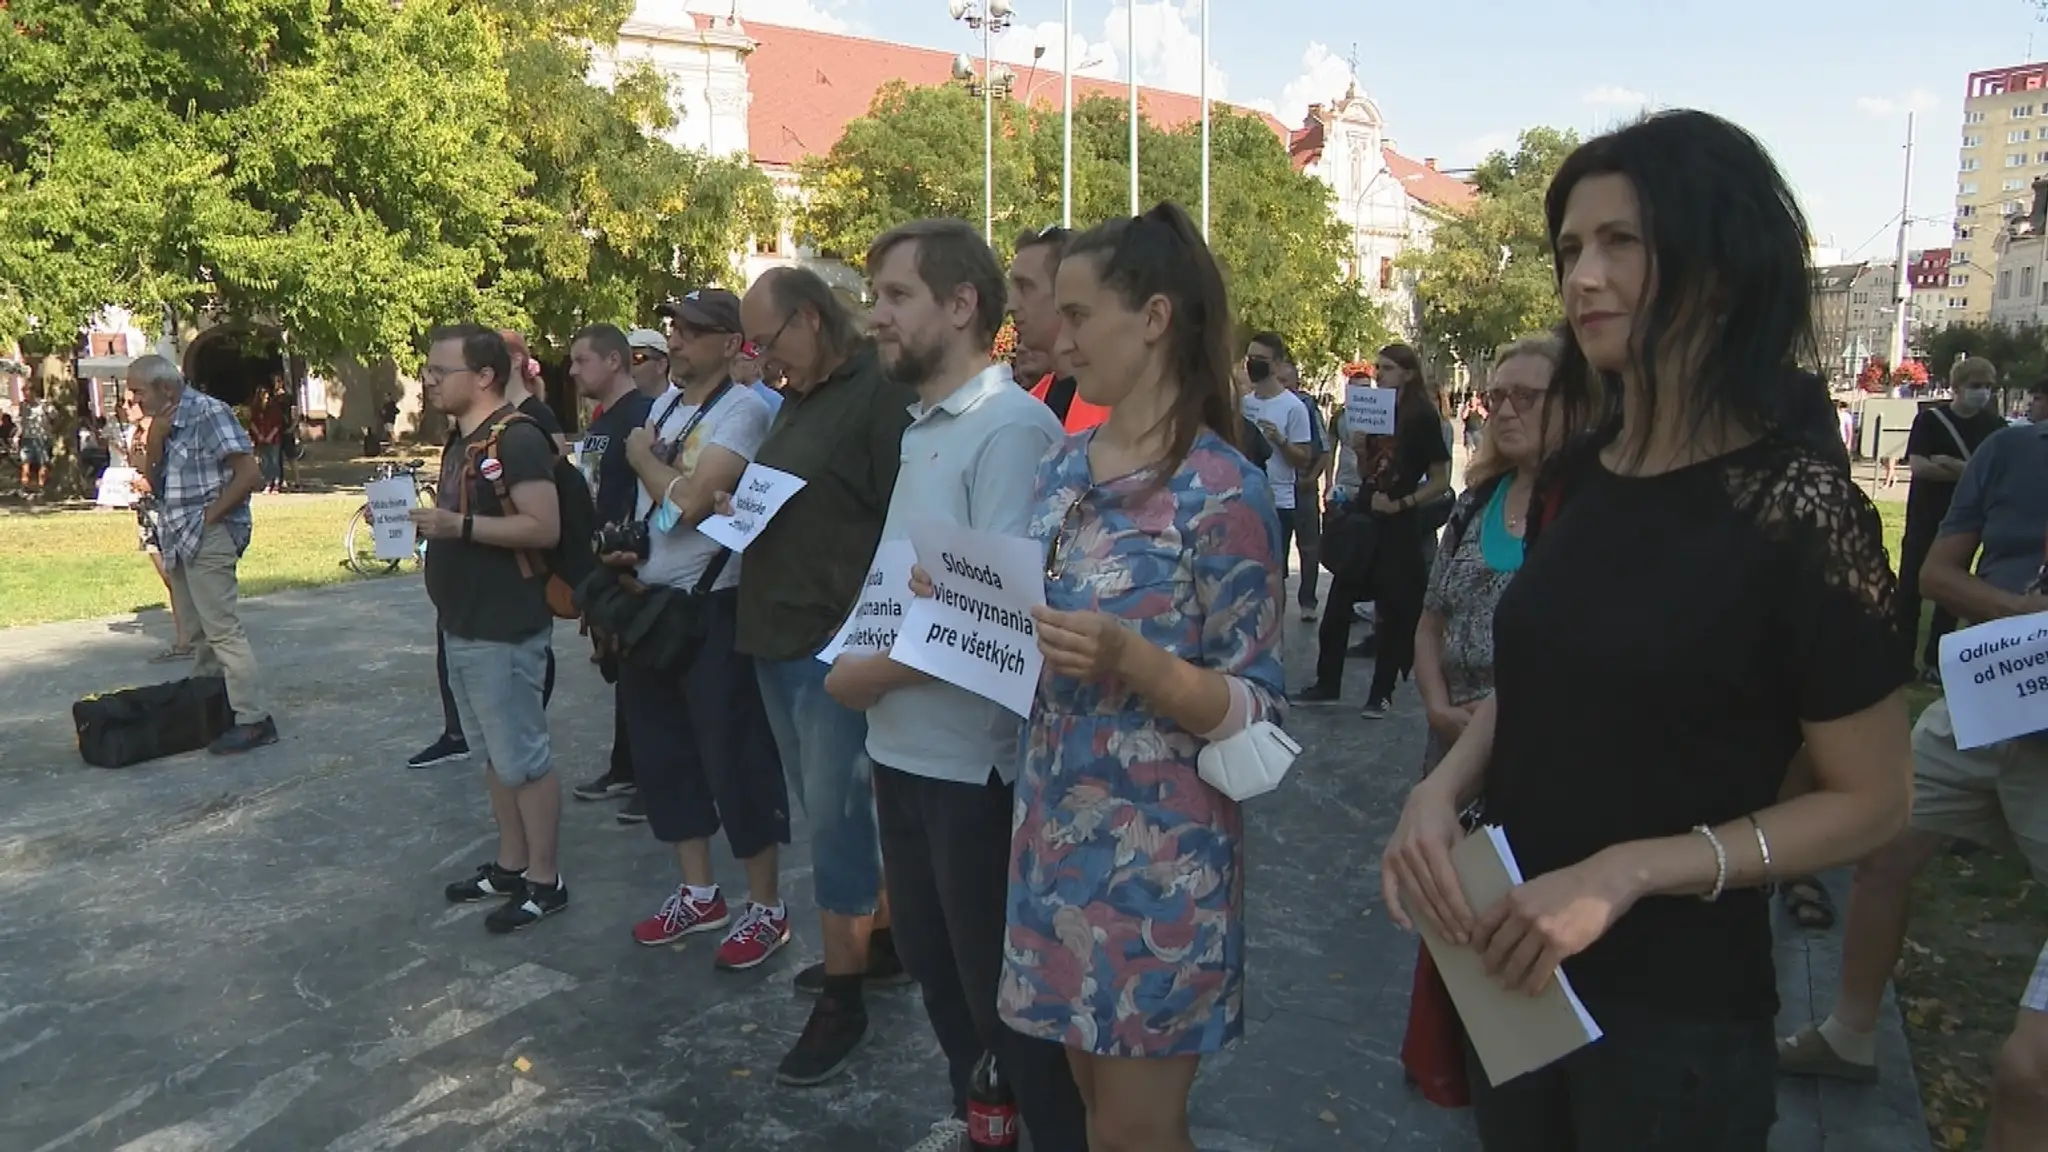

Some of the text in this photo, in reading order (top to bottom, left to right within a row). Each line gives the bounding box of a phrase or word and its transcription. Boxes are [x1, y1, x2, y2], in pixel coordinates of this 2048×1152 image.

[942, 552, 1003, 589] Sloboda
[934, 582, 1034, 636] vierovyznania
[926, 623, 1025, 675] pre všetkých
[1959, 636, 2022, 662] Odluku
[1974, 664, 1995, 684] od
